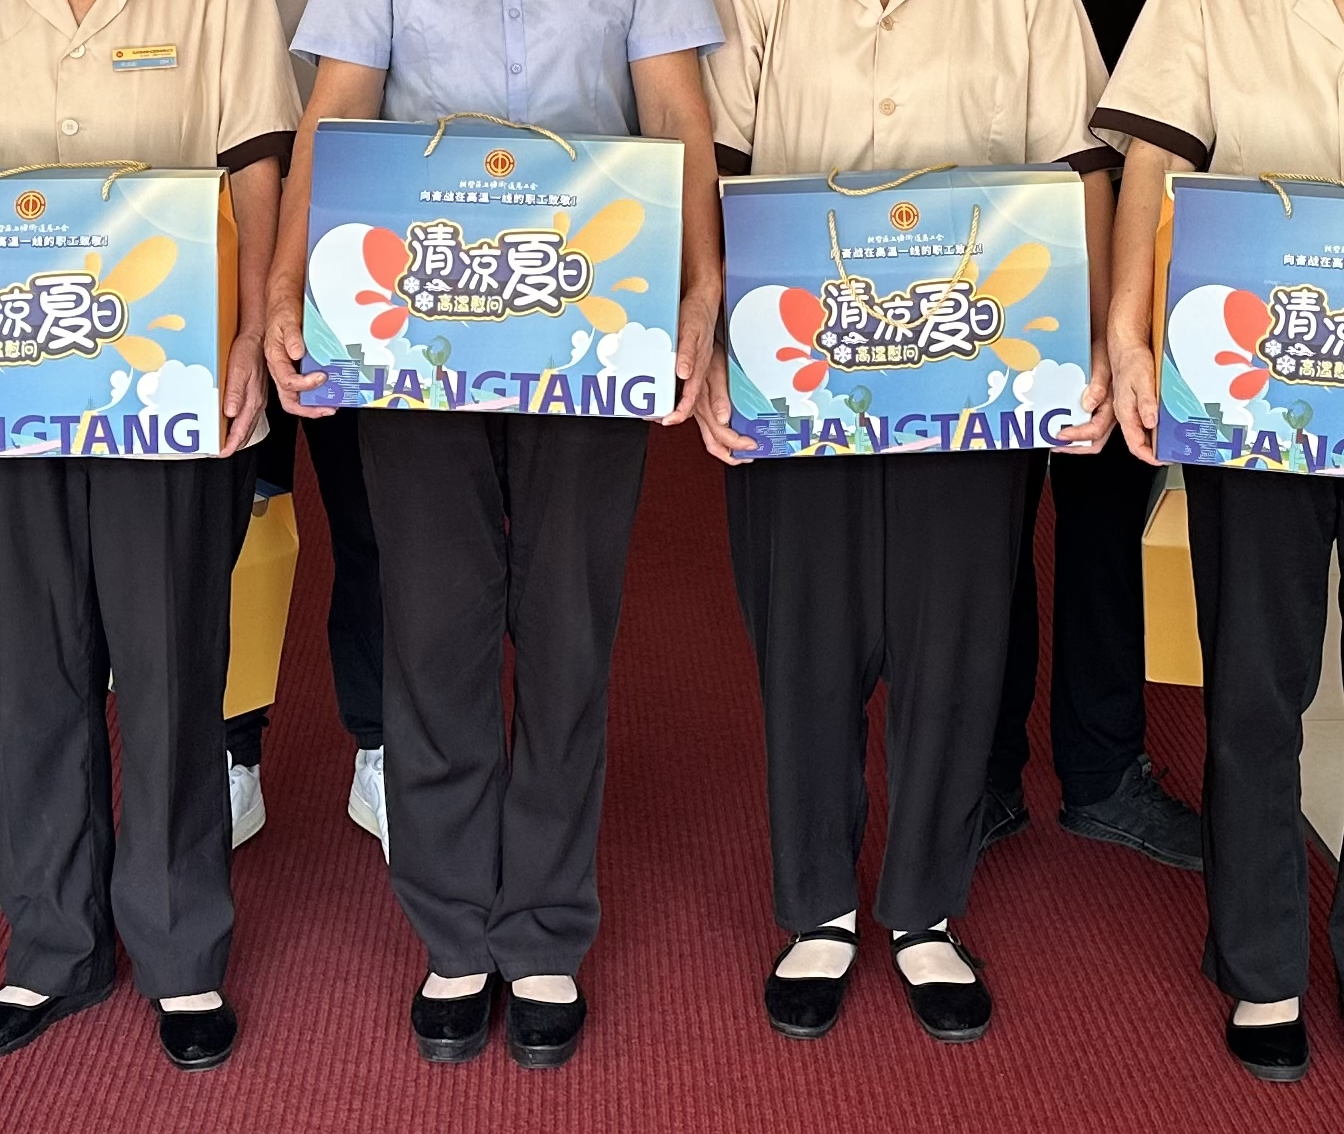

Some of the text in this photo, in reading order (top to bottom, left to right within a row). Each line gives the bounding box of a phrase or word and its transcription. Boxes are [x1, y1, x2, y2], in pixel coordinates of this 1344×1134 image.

[409, 224, 590, 308] 清凉夏日
[436, 294, 503, 315] 高温慰问
[824, 281, 999, 353] 清凉夏日
[854, 345, 919, 364] 高温慰问
